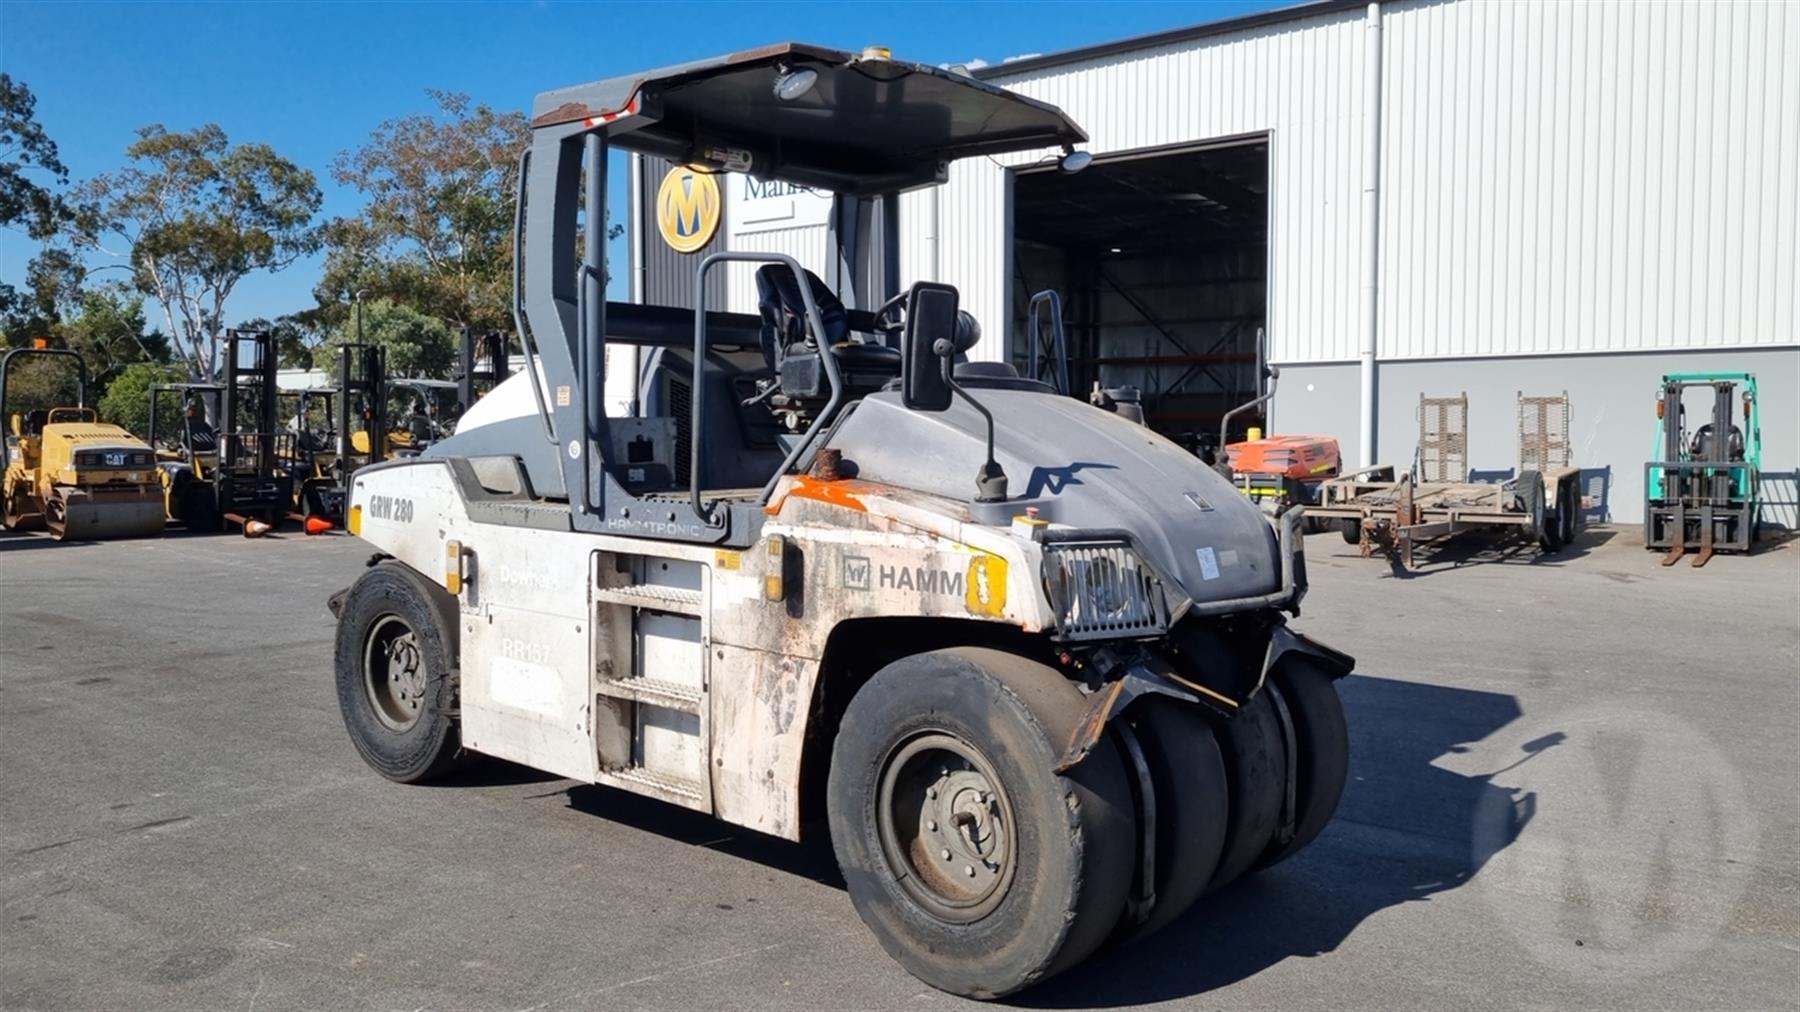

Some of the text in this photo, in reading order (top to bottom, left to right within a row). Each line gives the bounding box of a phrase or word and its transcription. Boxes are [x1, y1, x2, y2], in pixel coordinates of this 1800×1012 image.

[105, 453, 127, 466] CAT
[370, 494, 414, 523] GRW 280
[879, 564, 963, 597] HAMM
[502, 638, 551, 664] RR157
